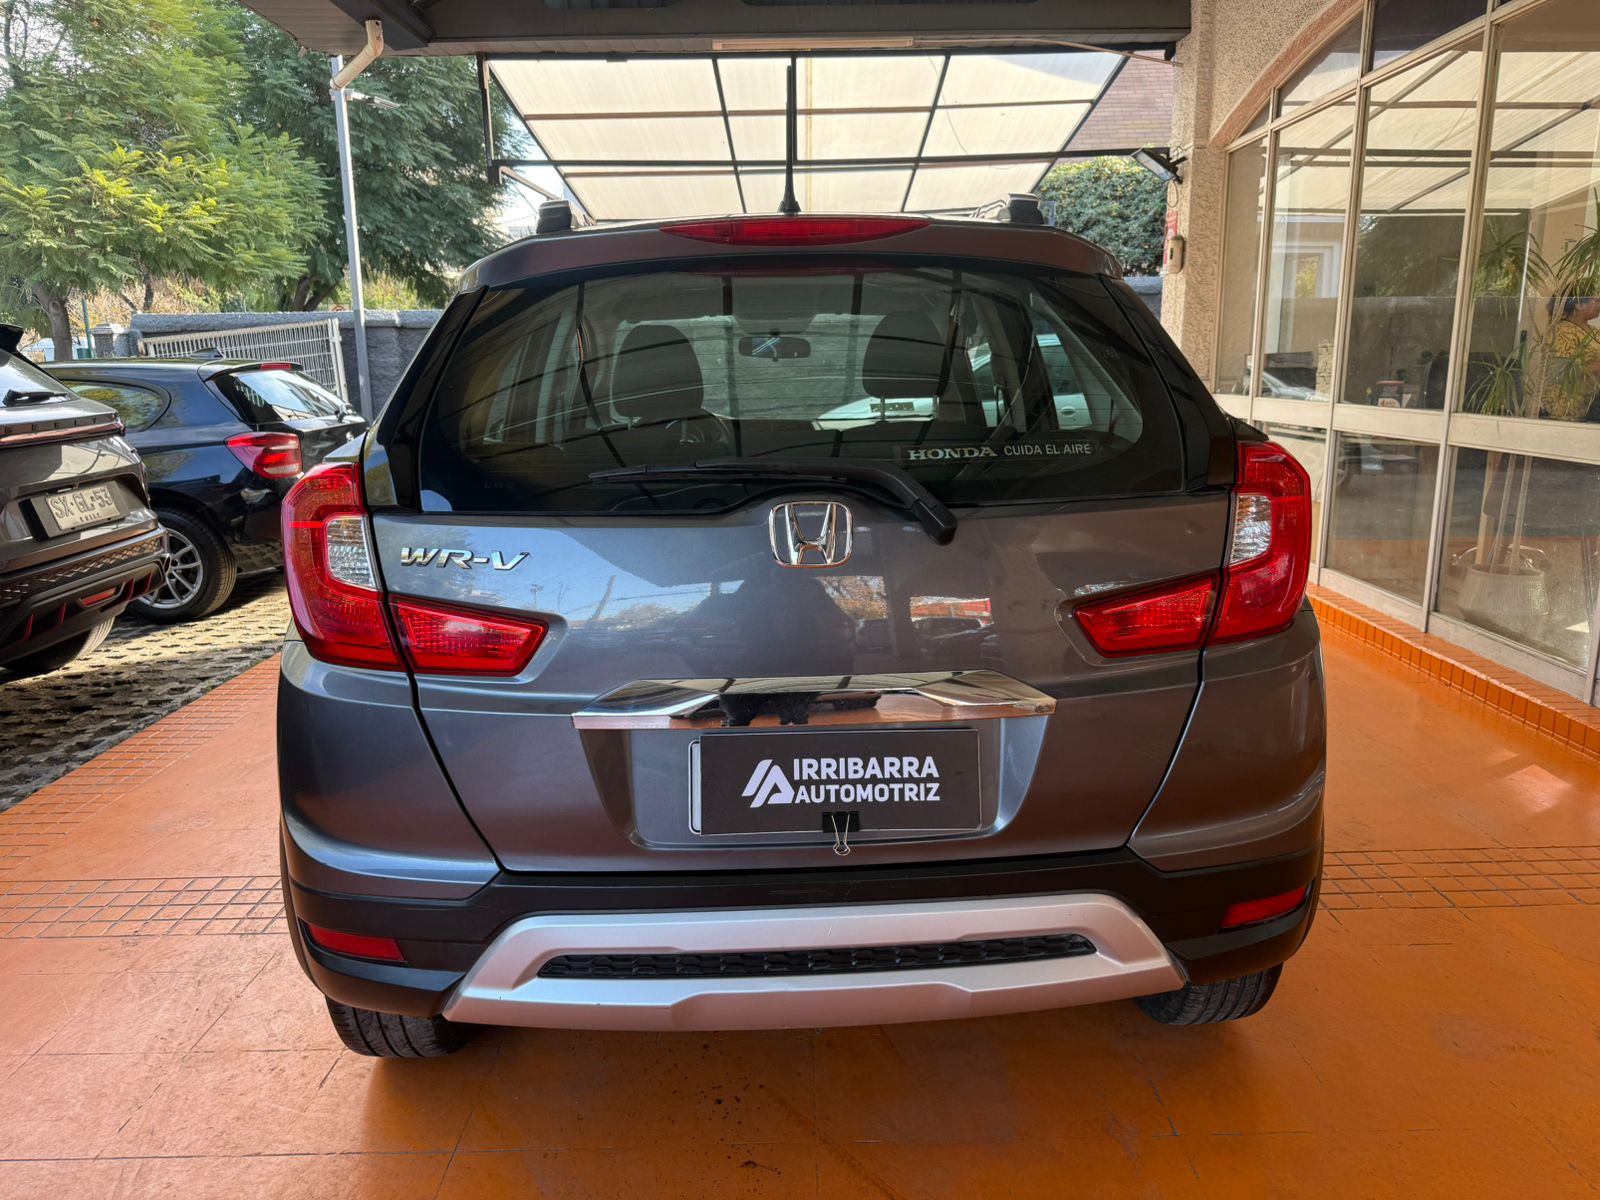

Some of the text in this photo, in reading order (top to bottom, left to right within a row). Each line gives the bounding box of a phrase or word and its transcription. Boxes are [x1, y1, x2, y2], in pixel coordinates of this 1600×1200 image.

[907, 443, 1092, 461] HONDA CUIDA EL AIRE
[400, 547, 533, 571] WR-V
[793, 756, 940, 781] IRRIBARRA
[794, 783, 941, 804] AUTOMOTRIZ
